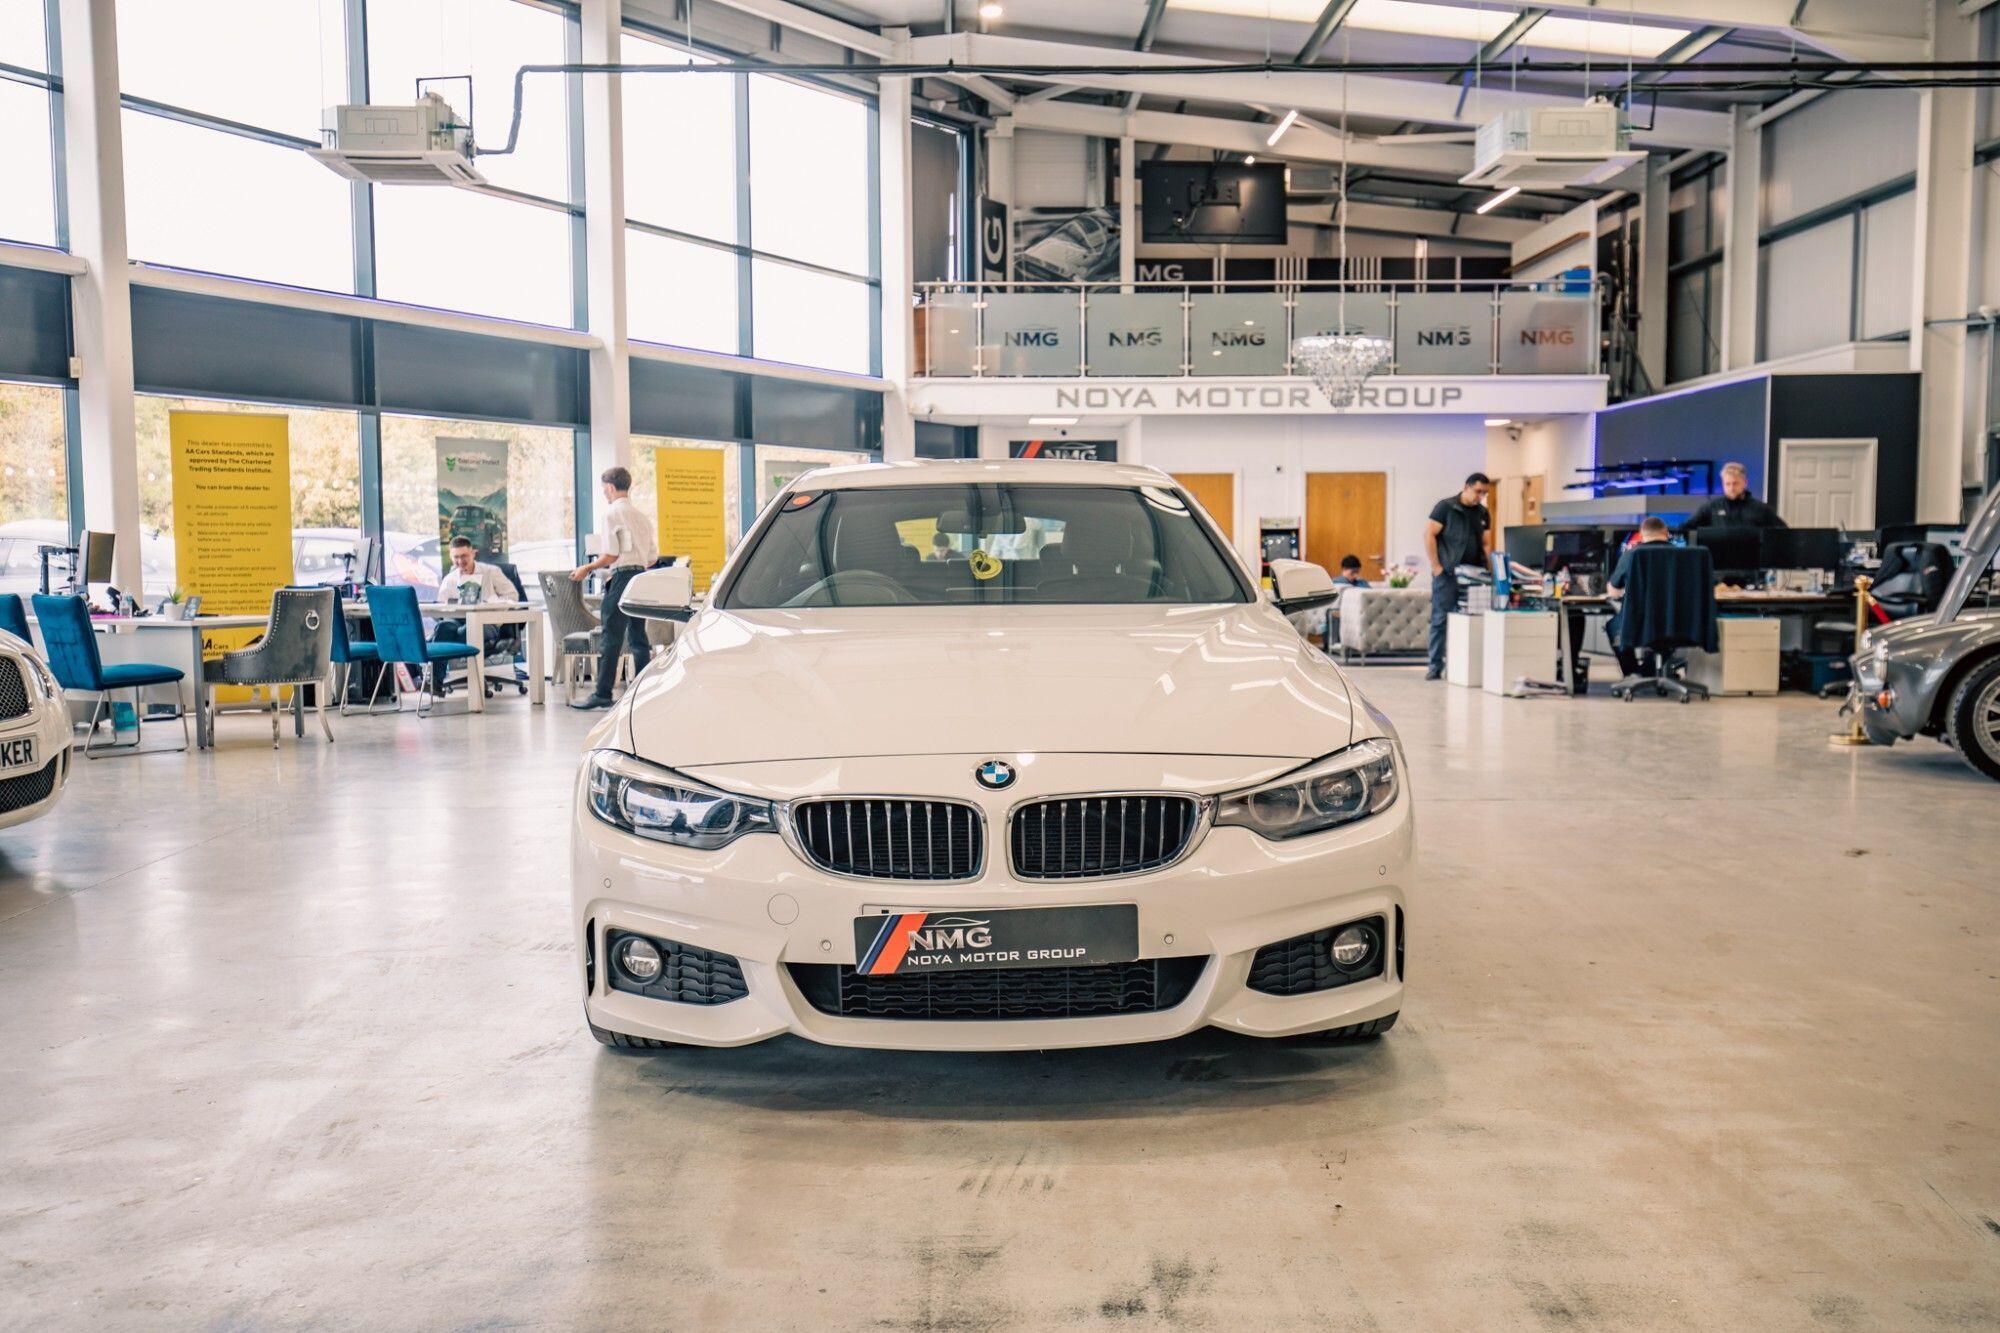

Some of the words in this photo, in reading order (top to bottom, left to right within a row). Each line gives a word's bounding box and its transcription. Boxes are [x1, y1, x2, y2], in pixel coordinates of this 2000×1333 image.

[1138, 264, 1184, 281] MG
[1004, 332, 1058, 346] NMG
[1109, 332, 1162, 346] NMG
[1212, 332, 1265, 346] NMG
[1418, 331, 1472, 346] NMG
[1520, 331, 1574, 346] NMG
[1056, 388, 1156, 408] NOYA
[1176, 387, 1310, 408] MOTOR
[1358, 386, 1462, 408] ROUP
[0, 738, 32, 767] KER
[907, 927, 992, 951] NMG
[907, 955, 952, 965] NOYA
[960, 951, 1020, 963] MOTOR
[1027, 947, 1086, 959] GROUP
